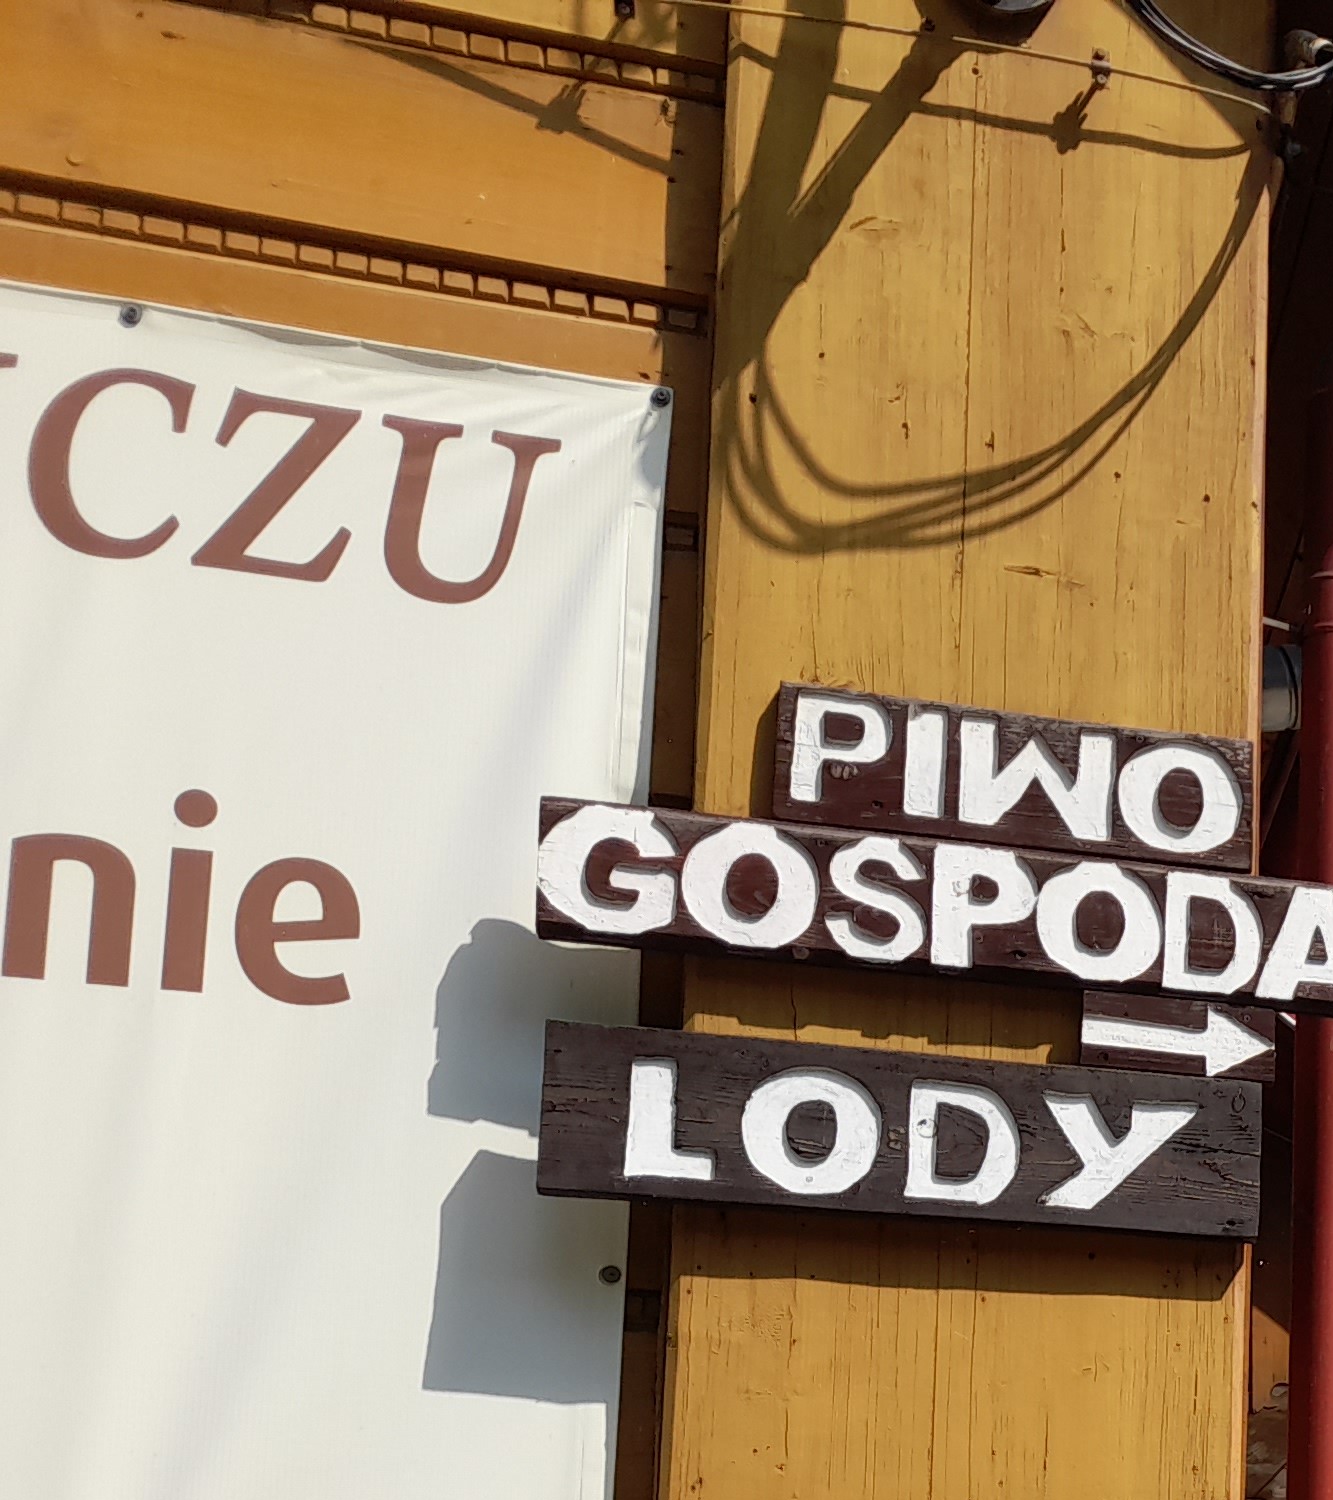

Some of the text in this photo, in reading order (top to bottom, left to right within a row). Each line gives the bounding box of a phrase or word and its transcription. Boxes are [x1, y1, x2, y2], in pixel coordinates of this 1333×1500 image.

[0, 353, 561, 604] CZU
[789, 692, 1243, 854] PIWO
[624, 1059, 1199, 1211] LODY
